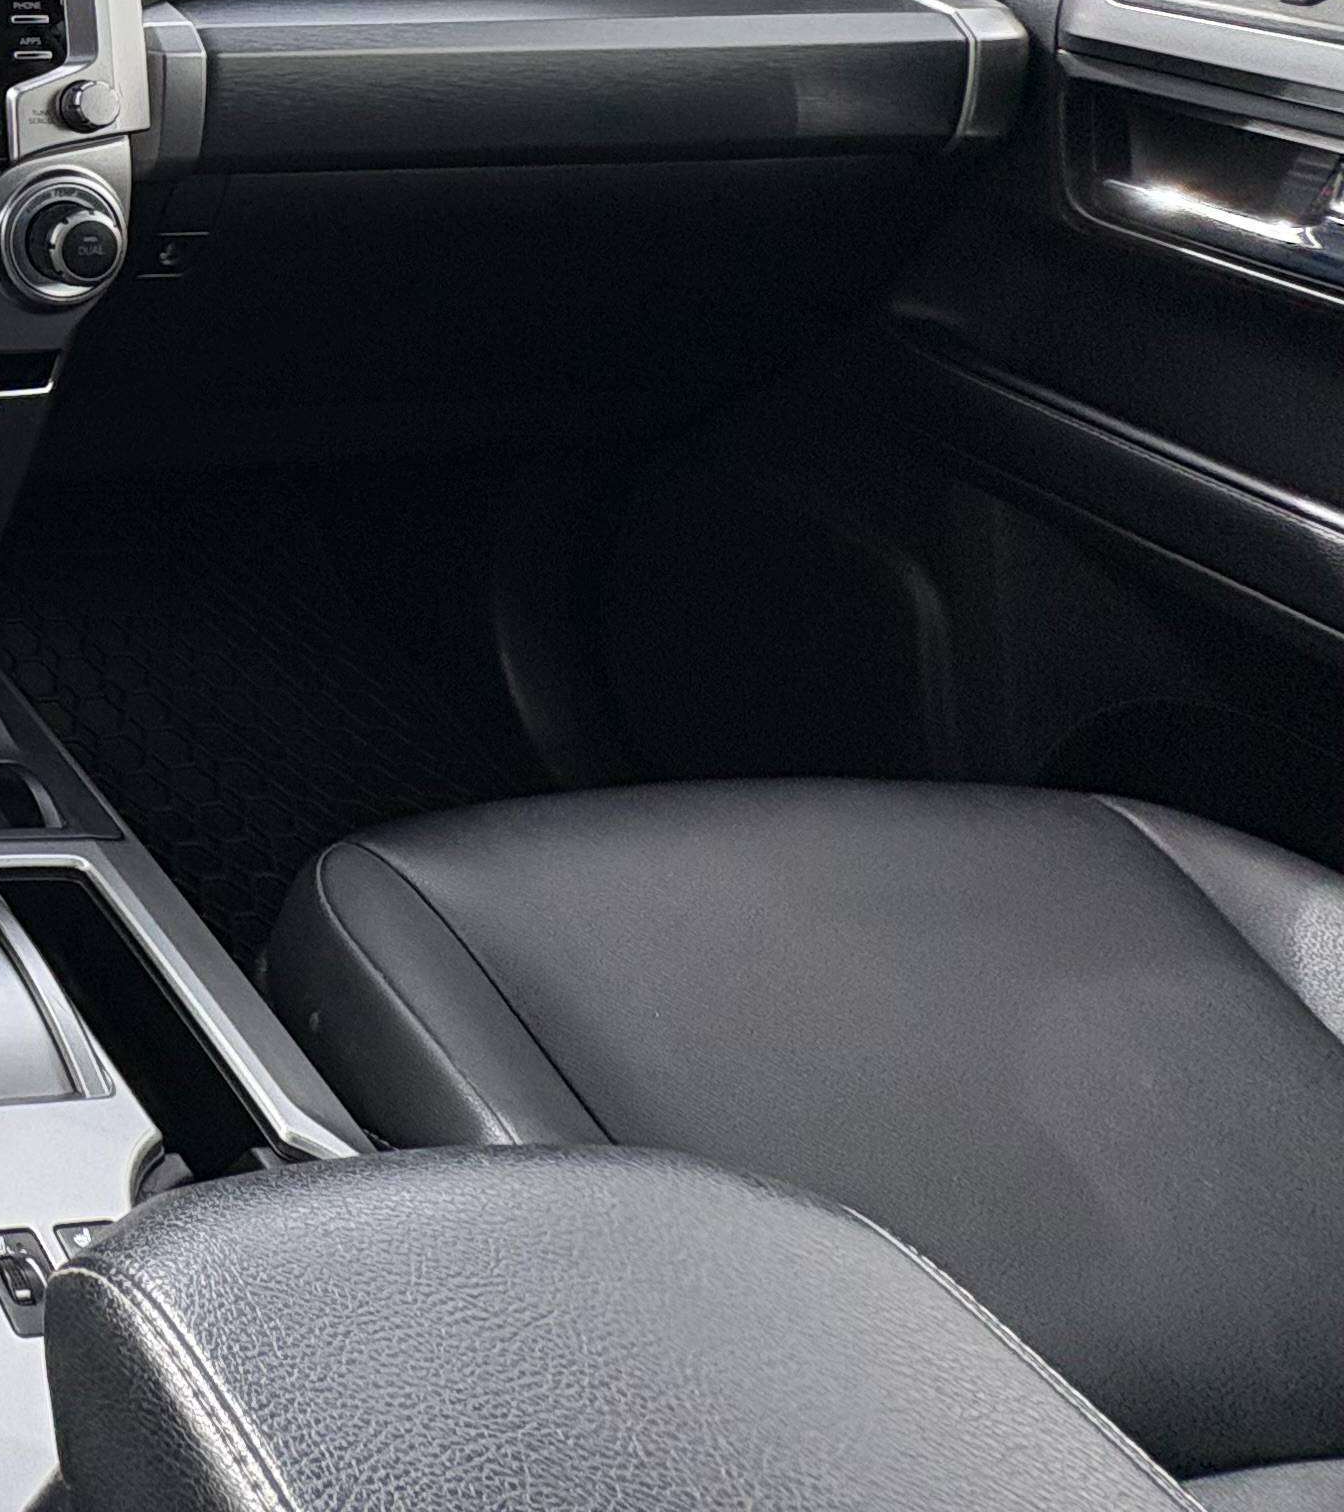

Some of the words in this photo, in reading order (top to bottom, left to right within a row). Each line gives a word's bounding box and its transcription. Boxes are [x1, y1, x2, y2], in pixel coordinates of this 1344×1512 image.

[13, 1, 42, 10] PHONE
[19, 37, 42, 46] APPS
[77, 245, 105, 256] DUAL
